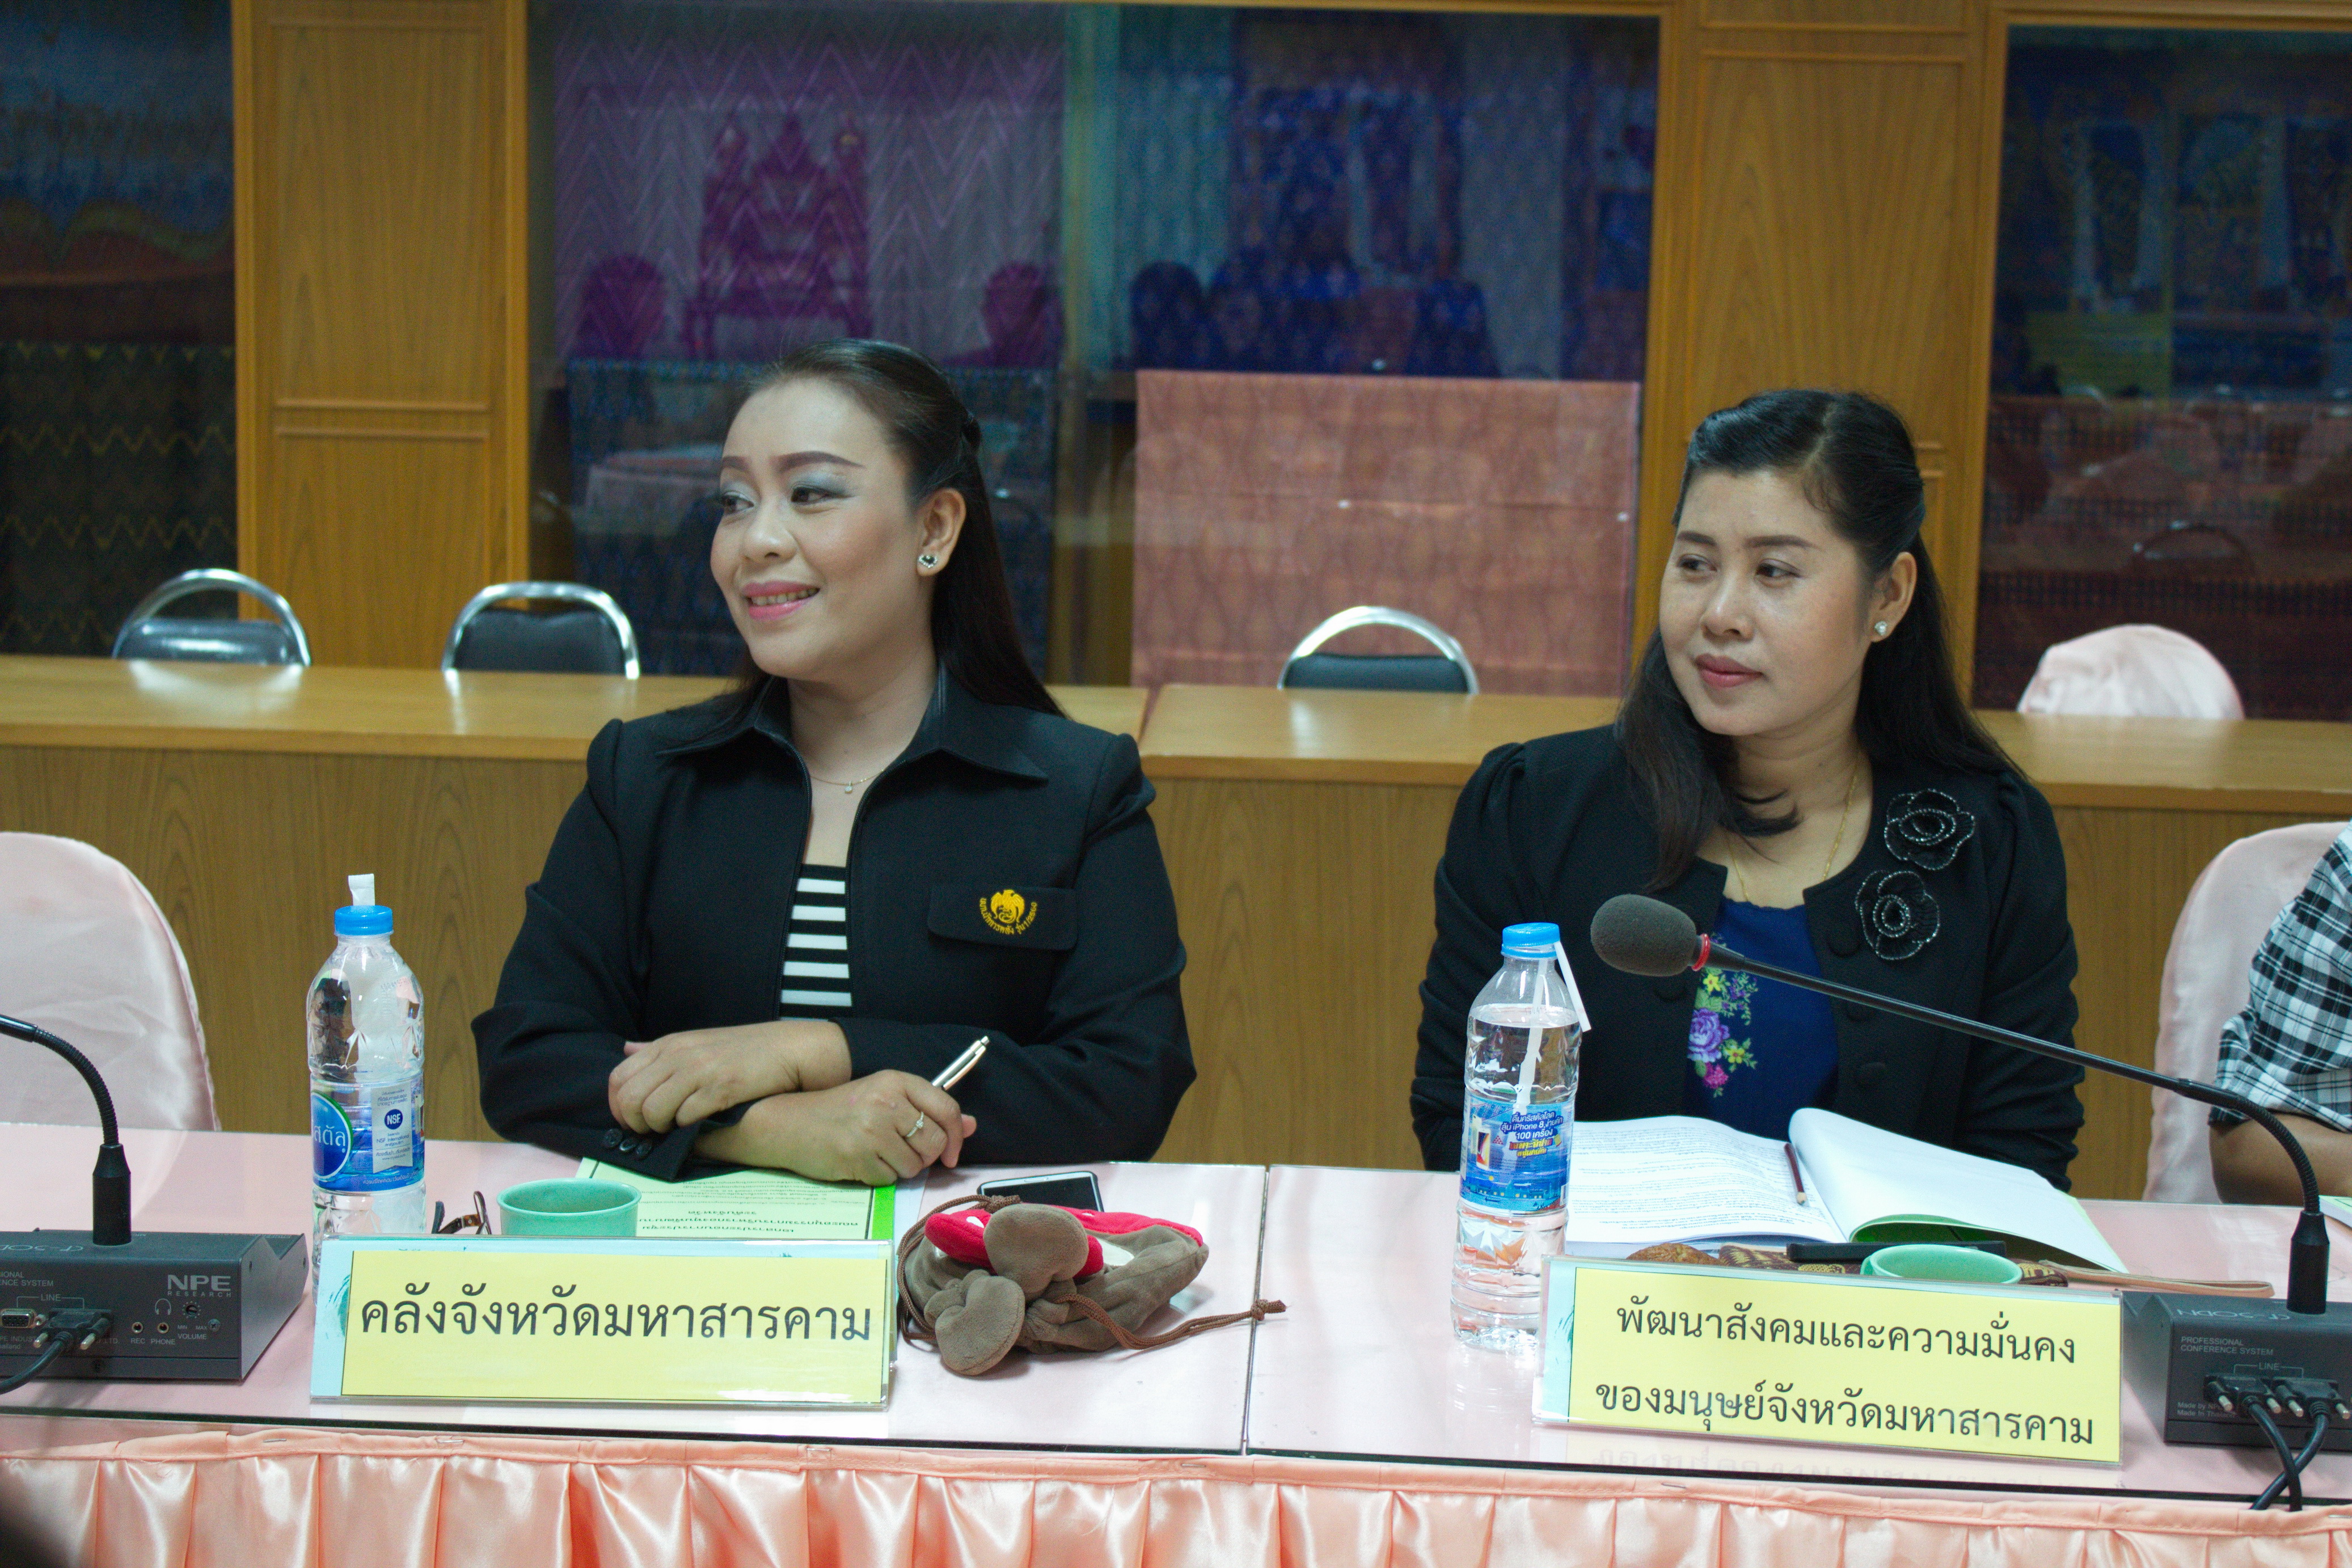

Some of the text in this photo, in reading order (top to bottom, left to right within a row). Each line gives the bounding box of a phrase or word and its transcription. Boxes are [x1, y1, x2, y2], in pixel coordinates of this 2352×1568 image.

[387, 1113, 401, 1125] NSF
[1516, 1131, 1531, 1140] 100
[167, 1274, 231, 1292] NPE
[40, 1293, 61, 1301] LINE
[362, 1282, 870, 1339] คลังจังหวัดมหาสารคาม
[1617, 1296, 2075, 1363] พัฒนาสังคมและความมั่นคง
[2181, 1335, 2244, 1346] PROFESSIONAL
[2180, 1345, 2274, 1356] CONFERENCE SYSTEM
[2258, 1362, 2280, 1371] LINE
[1596, 1379, 2093, 1444] ของมนุษย์จังหวัดมหาสารคาม
